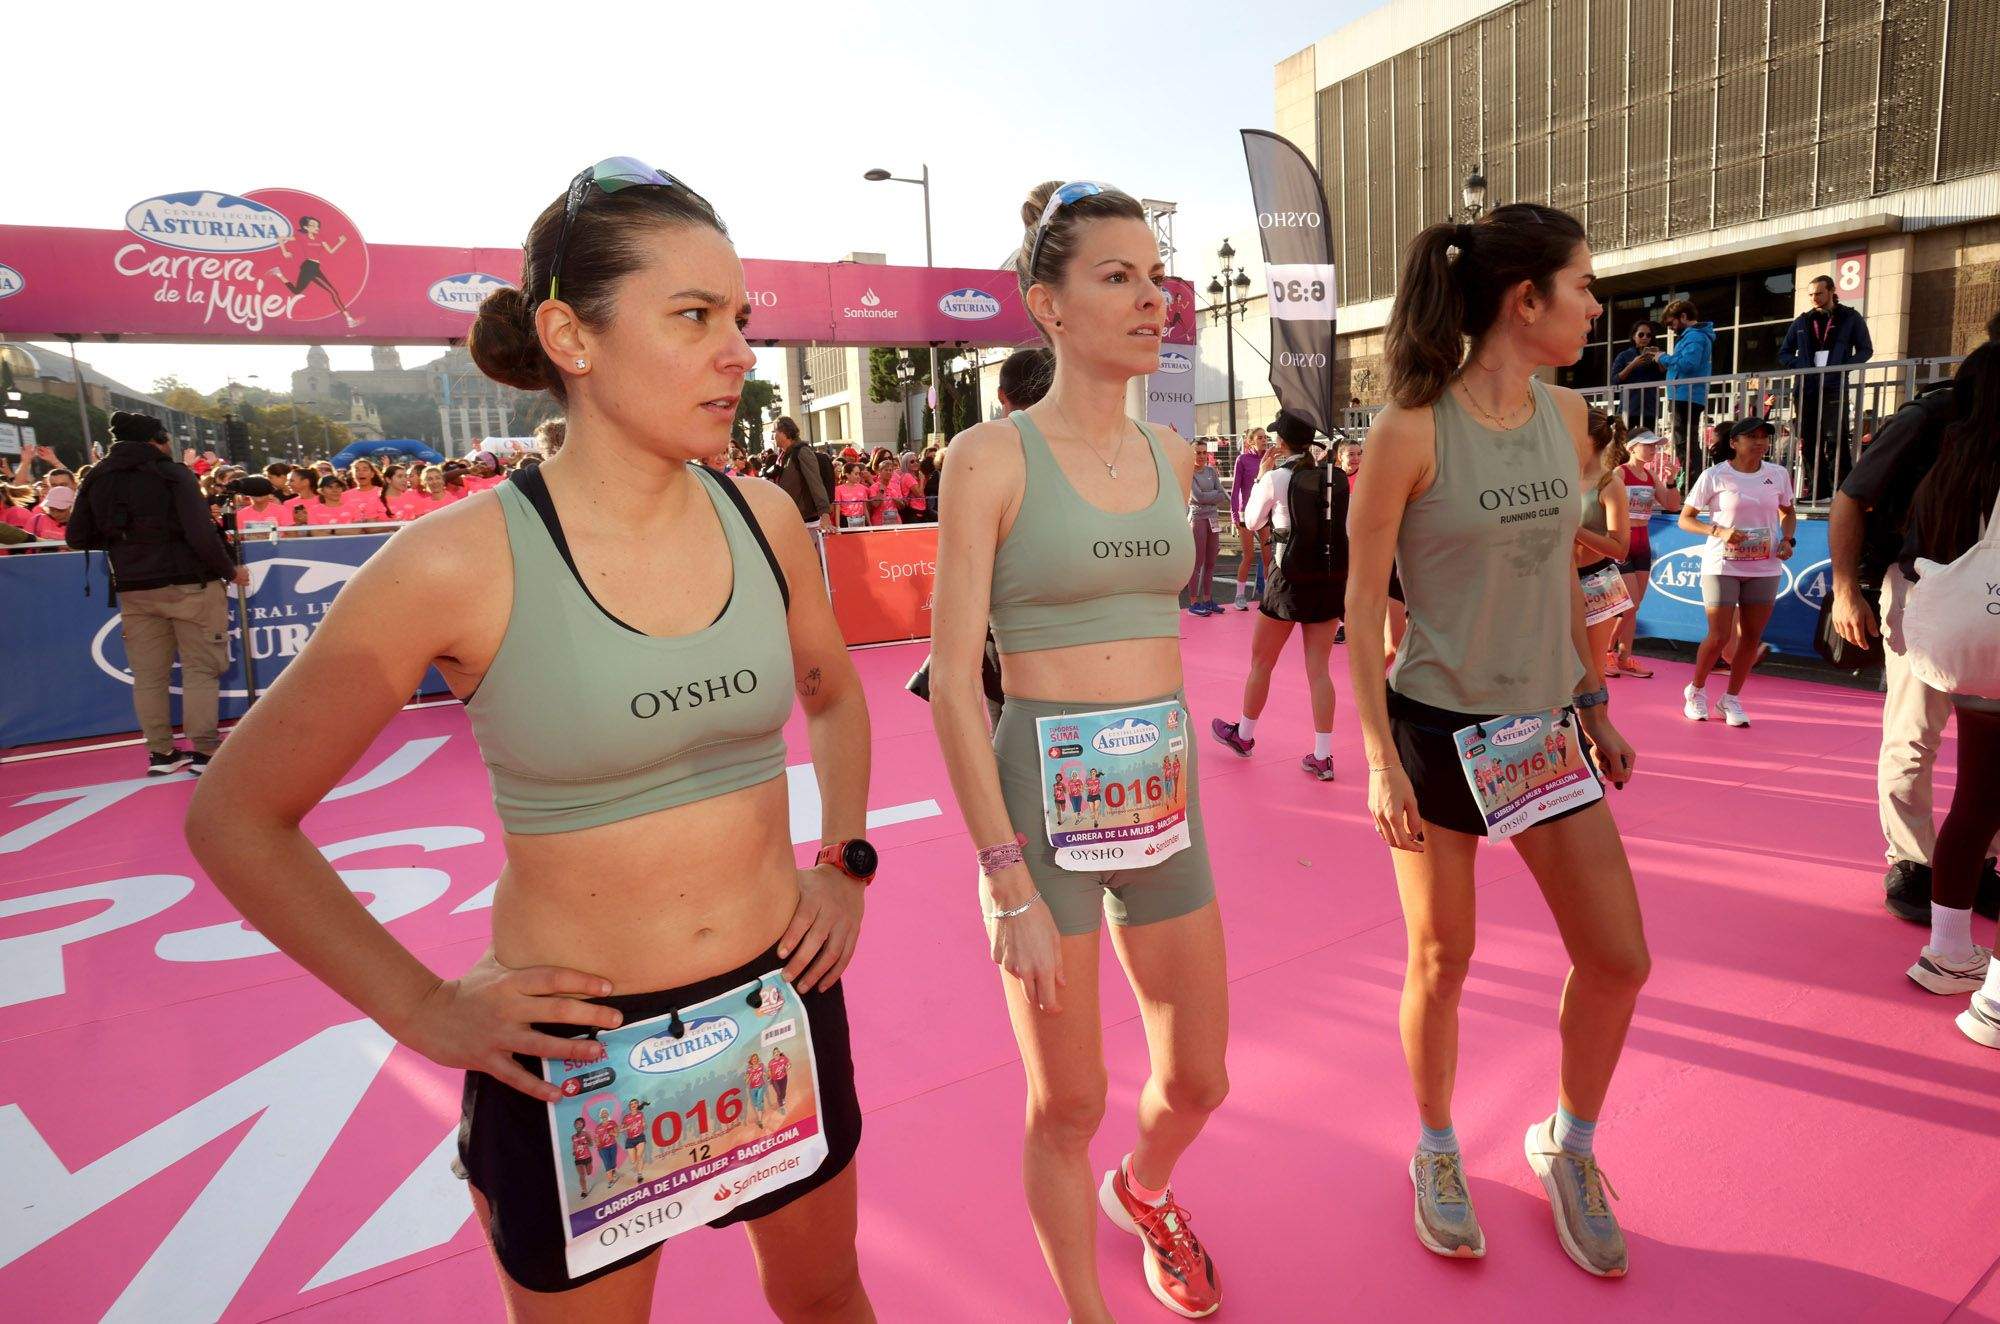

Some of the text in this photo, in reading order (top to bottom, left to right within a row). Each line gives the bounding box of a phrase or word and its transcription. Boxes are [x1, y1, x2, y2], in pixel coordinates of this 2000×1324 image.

[139, 208, 280, 239] ASTURIANA
[114, 243, 256, 281] Carrera
[1839, 260, 1861, 291] 8
[154, 279, 306, 332] de la Mujer
[843, 307, 899, 319] Santander
[942, 301, 997, 313] ASTURIANA
[1149, 391, 1193, 404] OYSHO
[1479, 478, 1569, 510] OYSHO
[1500, 507, 1560, 524] RUNNING CLUB
[1093, 539, 1170, 558] OYSHO
[631, 669, 757, 719] OYSHO
[1098, 731, 1157, 750] ASTURIANA
[1505, 752, 1545, 784] 016
[1104, 775, 1163, 808] 016
[1133, 812, 1141, 824] 3
[1500, 788, 1585, 834] OYSHO Santander
[1066, 831, 1103, 843] CARRERA
[1105, 831, 1116, 839] DE
[1118, 829, 1129, 838] LA
[1130, 824, 1155, 837] MUJER
[1071, 846, 1124, 860] OYSHO
[639, 1027, 734, 1069] ASTURIANA
[651, 1087, 744, 1148] 016
[688, 1144, 712, 1163] 12
[594, 1186, 651, 1221] CARRERA
[653, 1179, 671, 1195] DE
[672, 1175, 689, 1189] LA
[690, 1157, 730, 1181] MUJER
[737, 1126, 800, 1161] BARCELONA
[599, 1155, 801, 1247] OYSHO Santander
